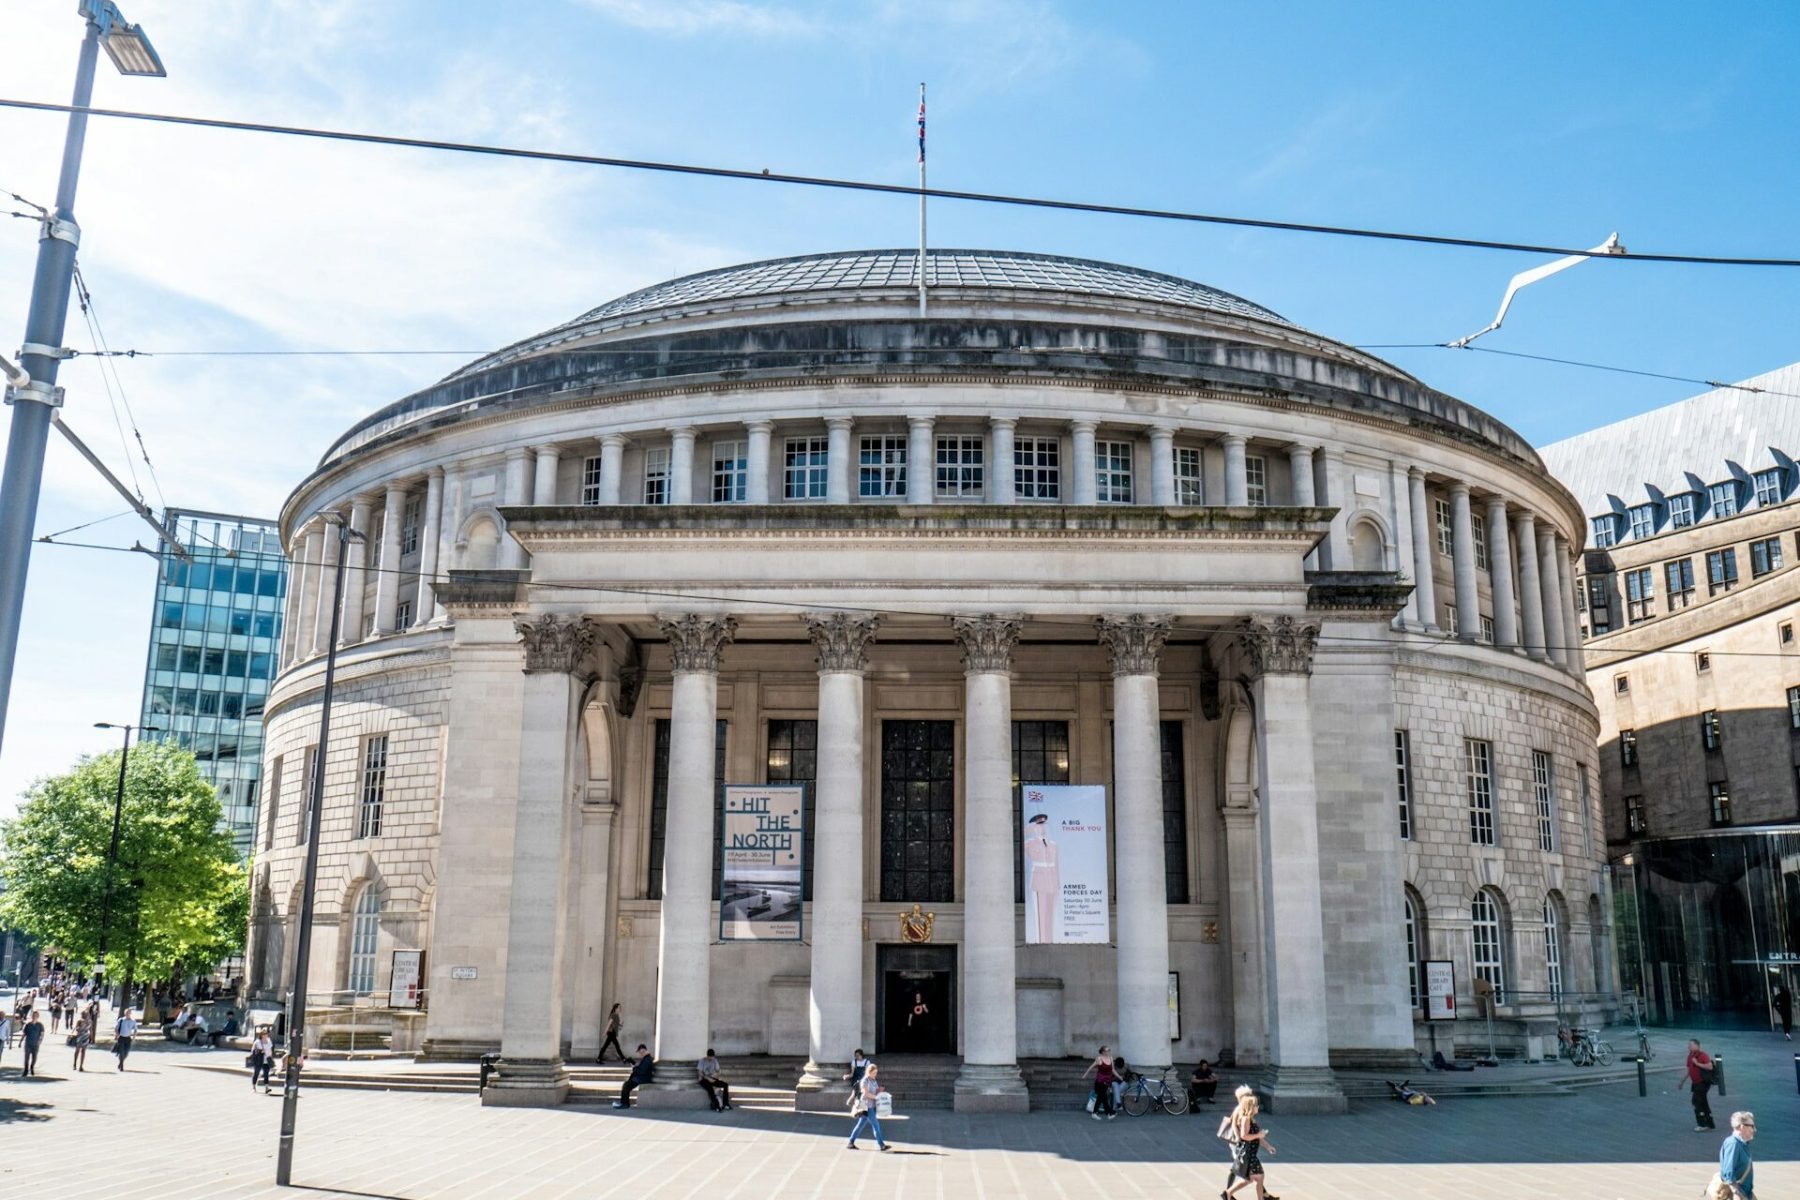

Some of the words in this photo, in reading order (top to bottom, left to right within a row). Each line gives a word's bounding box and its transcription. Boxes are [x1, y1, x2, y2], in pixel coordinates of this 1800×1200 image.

[742, 797, 771, 812] HIT
[756, 815, 790, 830] THE
[733, 833, 792, 849] NORTH
